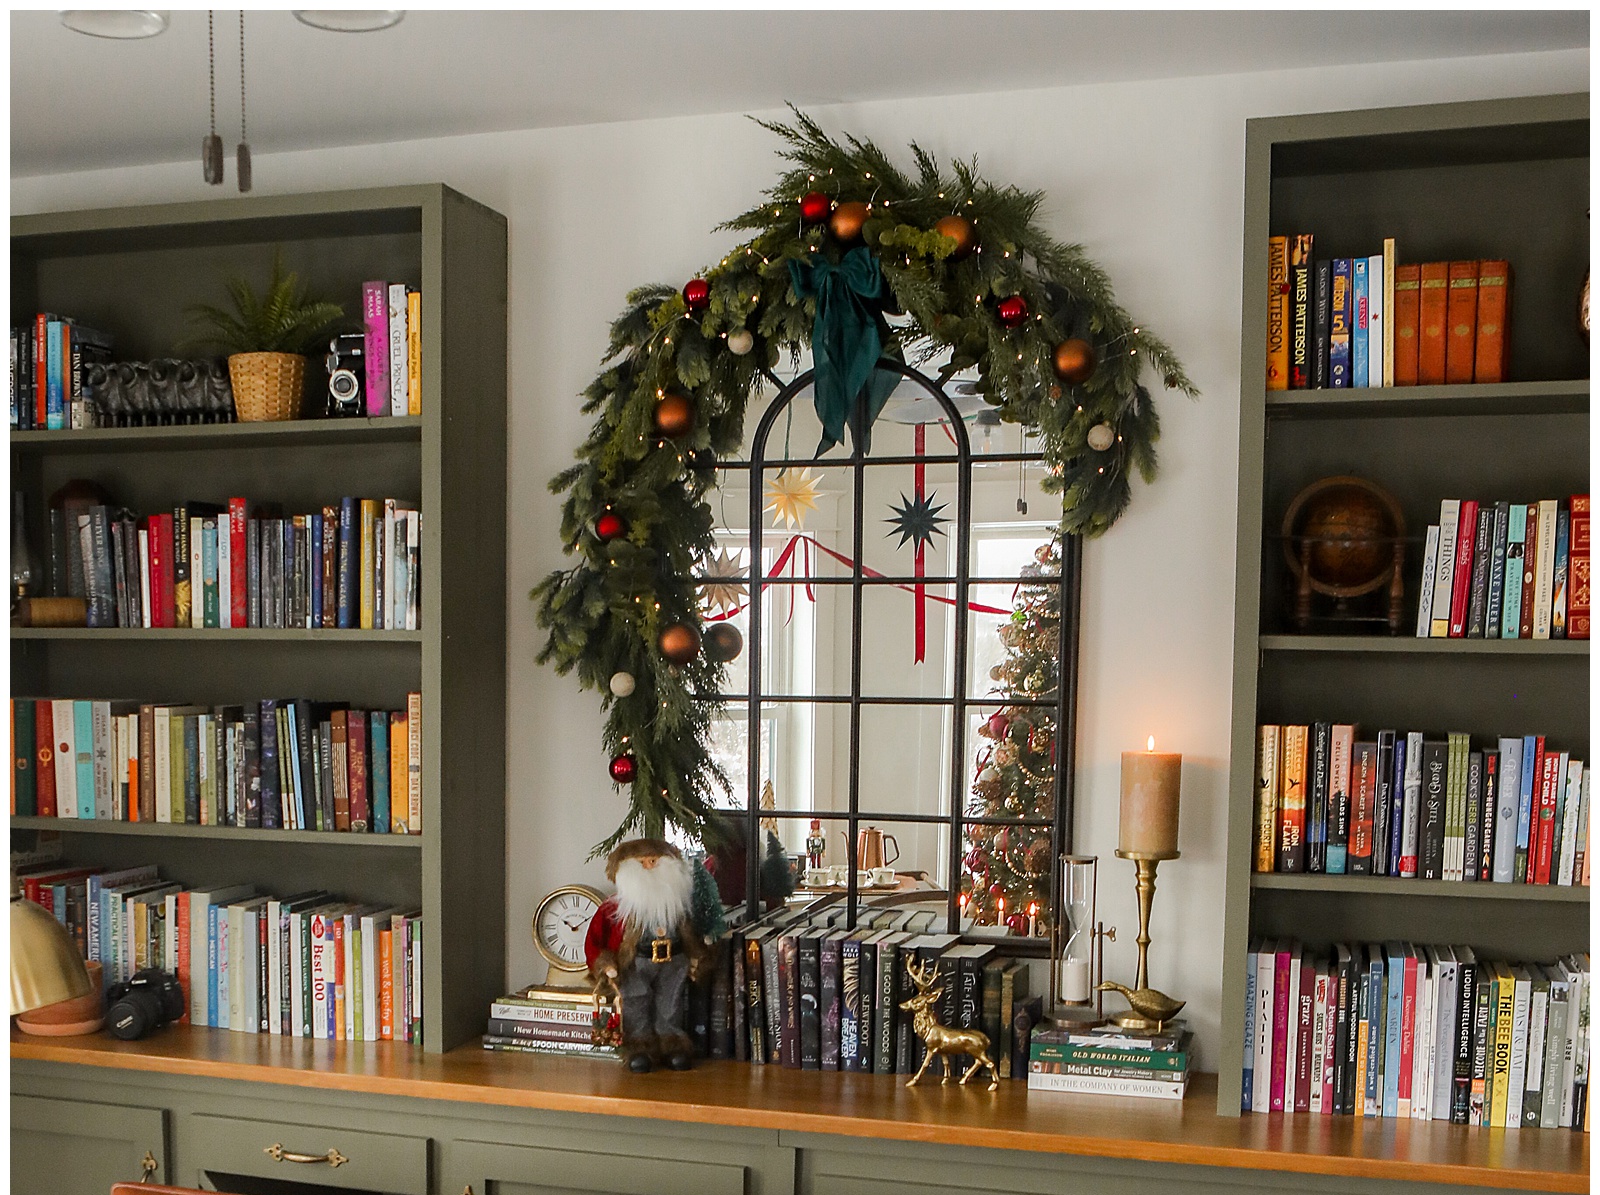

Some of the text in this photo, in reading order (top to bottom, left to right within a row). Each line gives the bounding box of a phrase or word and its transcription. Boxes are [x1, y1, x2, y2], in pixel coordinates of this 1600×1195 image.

[374, 290, 382, 316] SARAH
[1270, 242, 1282, 353] JAMES PATTERSON
[1294, 268, 1308, 365] JAMES PATTERSON
[73, 353, 81, 397] DAN BROWN
[1440, 536, 1454, 582] THINGS
[1460, 539, 1471, 566] salads
[1490, 559, 1503, 623] ANNE TYLER
[410, 697, 420, 710] THE
[411, 743, 419, 759] CODE
[1317, 752, 1325, 760] in
[411, 778, 419, 816] DAN BROWN
[1339, 776, 1347, 816] CRAWDADS
[1541, 758, 1552, 805] WILD CHILD
[1466, 764, 1479, 865] COOK'S HERB GARDEN
[1483, 797, 1494, 853] HUNGER GAMES
[1263, 819, 1272, 852] FOURTH
[1281, 819, 1292, 852] FLAME
[1291, 826, 1299, 847] IRON
[90, 902, 101, 961] NEW AMERIC
[111, 896, 119, 937] PRACTICAL
[314, 945, 324, 975] Best
[883, 962, 892, 973] THE
[315, 977, 325, 1001] 100
[382, 980, 390, 989] &
[883, 974, 891, 994] GOD
[963, 972, 976, 992] FATE
[382, 991, 391, 1021] stir-fry
[533, 1009, 554, 1019] HOME
[883, 996, 891, 1006] OF
[1244, 973, 1255, 1049] AMAZING GLAZE
[1298, 995, 1312, 1026] graze
[1459, 969, 1472, 1058] LIQUID INTELLIGENCE
[1515, 998, 1528, 1033] TOAST
[517, 1026, 592, 1040] New Homemade Kitche
[861, 994, 870, 1047] SLEWFOOT
[882, 1020, 890, 1053] WOODS
[1326, 1005, 1336, 1060] Potato Salad
[1348, 989, 1358, 1062] ARTFUL WOODEN SPOON
[1370, 1025, 1378, 1044] home
[1402, 995, 1413, 1055] Discovering Dahlias
[1495, 995, 1512, 1075] THE BEE BOOK
[532, 1041, 594, 1052] SPOON CARVING
[841, 1017, 849, 1058] BREAKER
[848, 1020, 857, 1058] HEAVEN
[1439, 1008, 1451, 1077] The Foraged Home
[1565, 1037, 1573, 1061] BREW
[1067, 1064, 1113, 1078] Metal Clay
[1090, 1052, 1117, 1061] WORLD
[1118, 1055, 1151, 1063] ITALIAN
[1359, 1060, 1366, 1069] on
[1367, 1046, 1377, 1086] well-crafted
[1475, 1045, 1486, 1079] WELCOME
[1512, 1046, 1523, 1070] JAM
[1546, 1035, 1559, 1105] simply living well
[1062, 1079, 1078, 1088] THE
[1079, 1080, 1117, 1091] COMPANY
[1119, 1083, 1132, 1091] OF
[1133, 1083, 1164, 1094] WOMEN
[1357, 1070, 1366, 1091] plants
